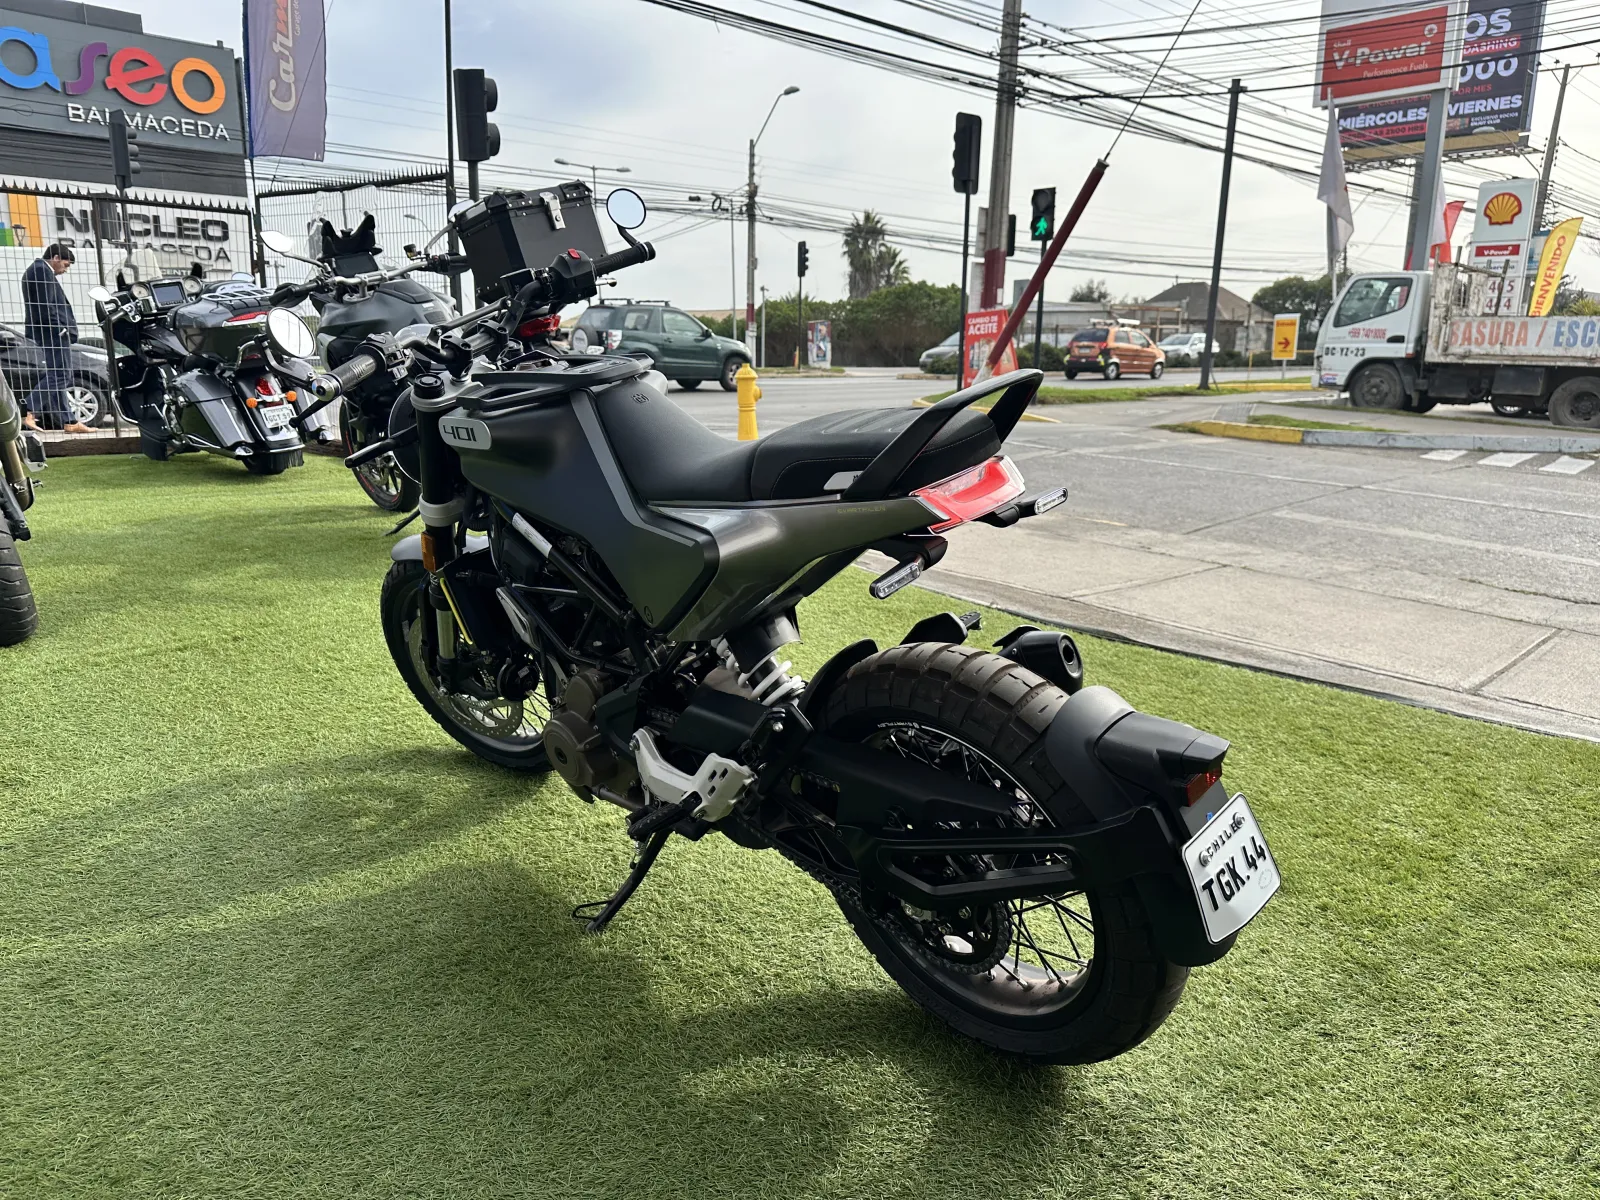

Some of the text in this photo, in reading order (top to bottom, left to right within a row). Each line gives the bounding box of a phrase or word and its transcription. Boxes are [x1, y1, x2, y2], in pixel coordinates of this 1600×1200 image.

[1332, 41, 1432, 70] V-Power
[1333, 40, 1352, 48] Shell
[0, 26, 226, 115] aseo
[1362, 60, 1429, 79] Performance Fuels
[1473, 84, 1493, 93] MES
[1338, 107, 1429, 130] MIÉRCOLES
[1447, 94, 1523, 117] VIERNES
[55, 206, 230, 242] NCLEO
[1483, 248, 1511, 257] V-Power
[1531, 235, 1567, 317] BIENVENIDO
[968, 315, 998, 325] CAMBIO DE
[968, 323, 998, 335] ACEITE
[1450, 320, 1529, 347] BASURA
[442, 424, 477, 442] 401
[1205, 820, 1240, 859] CHILE
